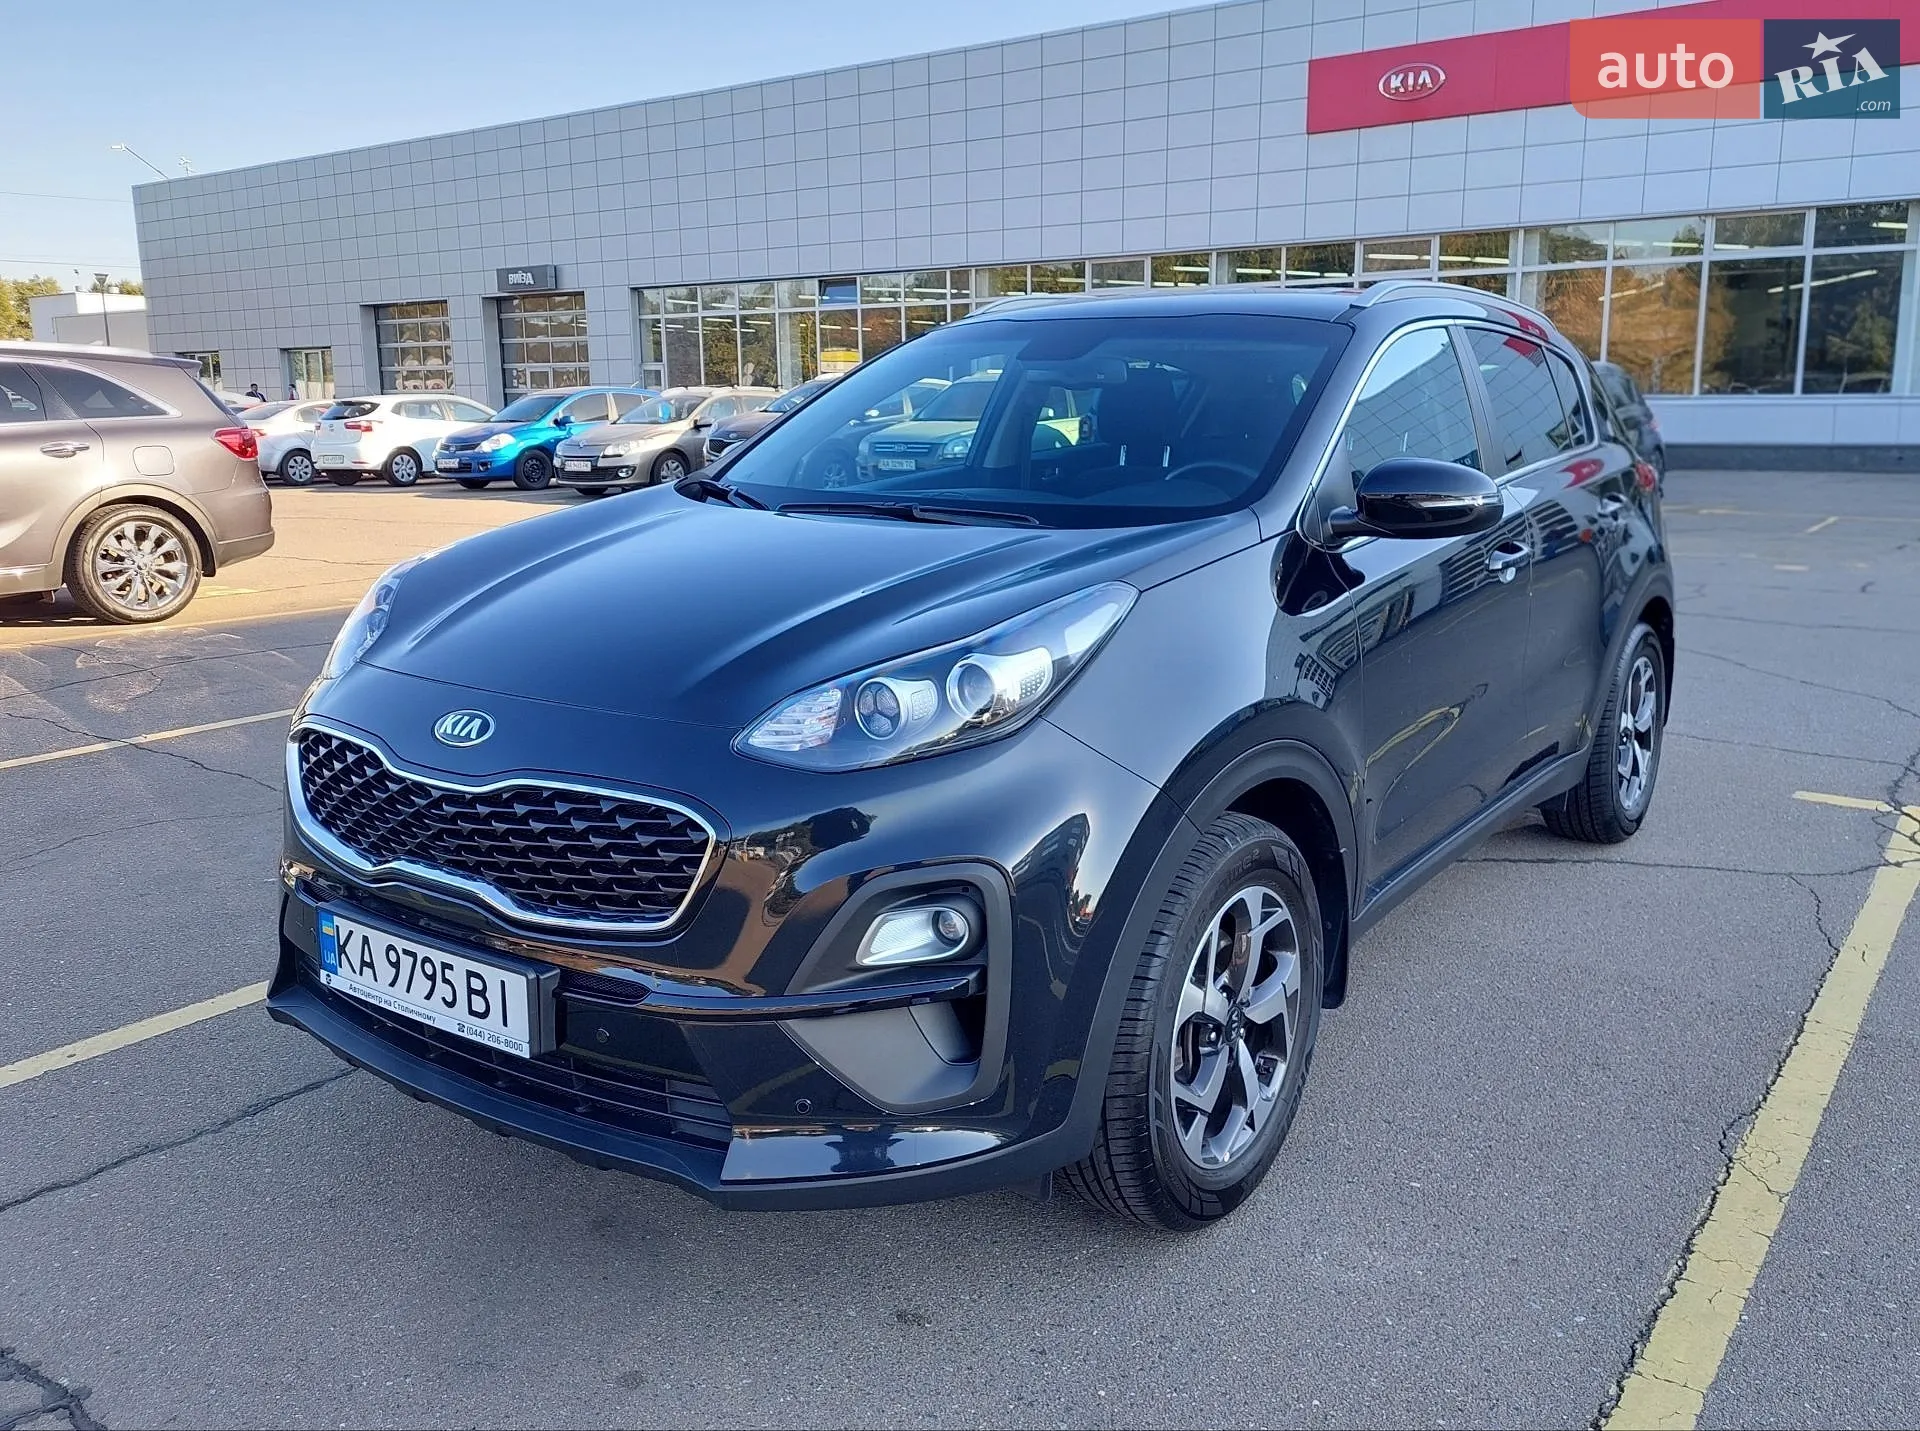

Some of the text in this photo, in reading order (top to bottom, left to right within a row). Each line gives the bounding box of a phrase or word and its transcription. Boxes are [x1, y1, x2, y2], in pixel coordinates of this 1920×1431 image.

[1391, 70, 1433, 93] KIA
[440, 714, 482, 740] KIA
[324, 950, 336, 966] UA
[335, 924, 508, 1027] KA 9795 BI
[349, 983, 436, 1024] Автоцентр на Столичному
[466, 1026, 524, 1052] (044) 206-8000
